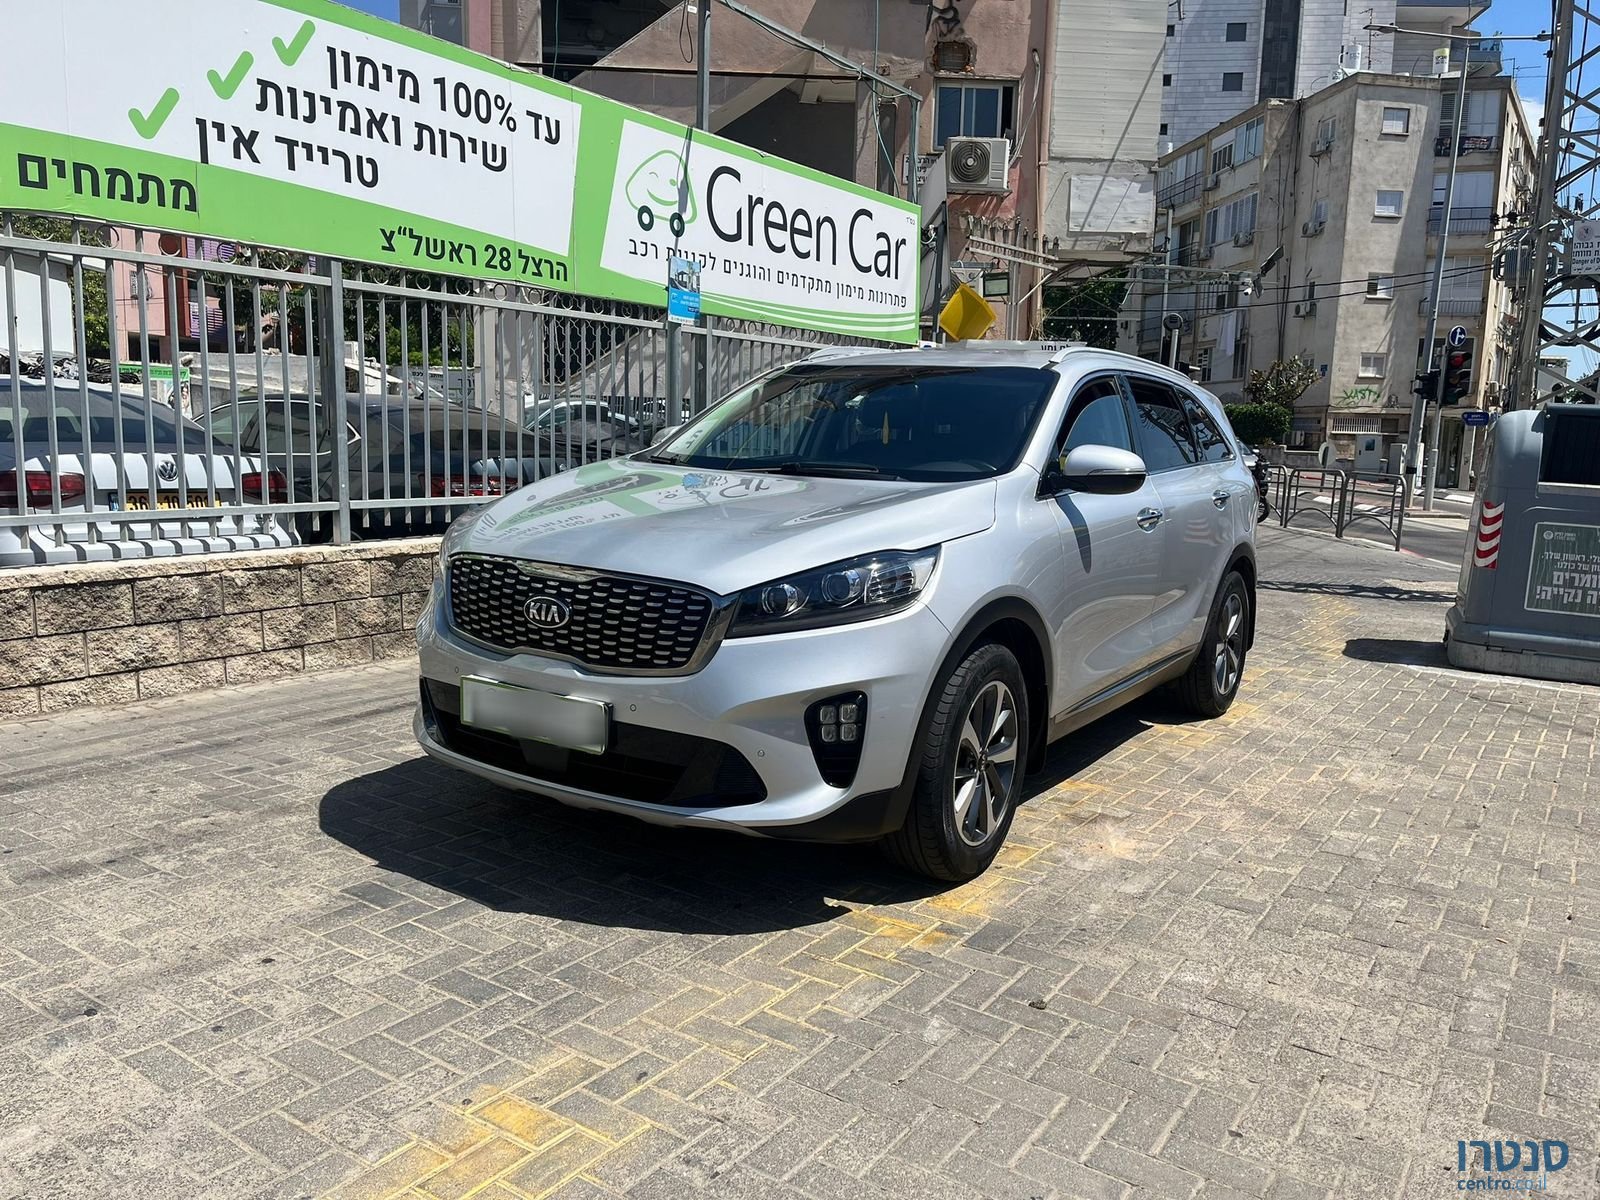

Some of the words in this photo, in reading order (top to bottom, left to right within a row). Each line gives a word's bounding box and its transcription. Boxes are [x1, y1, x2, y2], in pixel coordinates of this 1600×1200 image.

[326, 46, 420, 103] מימון
[256, 78, 402, 146] ואמינות
[434, 77, 517, 132] 100%
[195, 117, 261, 164] אין
[526, 110, 561, 145] עד
[275, 135, 379, 187] טרייד
[413, 121, 507, 172] שירות
[18, 153, 197, 212] מתמחים
[706, 165, 837, 265] Green
[848, 208, 907, 280] Car
[483, 244, 512, 271] 28
[517, 248, 568, 282] הרצל
[629, 239, 658, 260] רכב
[723, 259, 771, 282] והוגנים
[777, 270, 832, 293] מתקדמים
[836, 282, 864, 300] מימון
[869, 289, 907, 308] פתרונות
[1536, 585, 1583, 604] נקייה!
[529, 602, 560, 622] KIA
